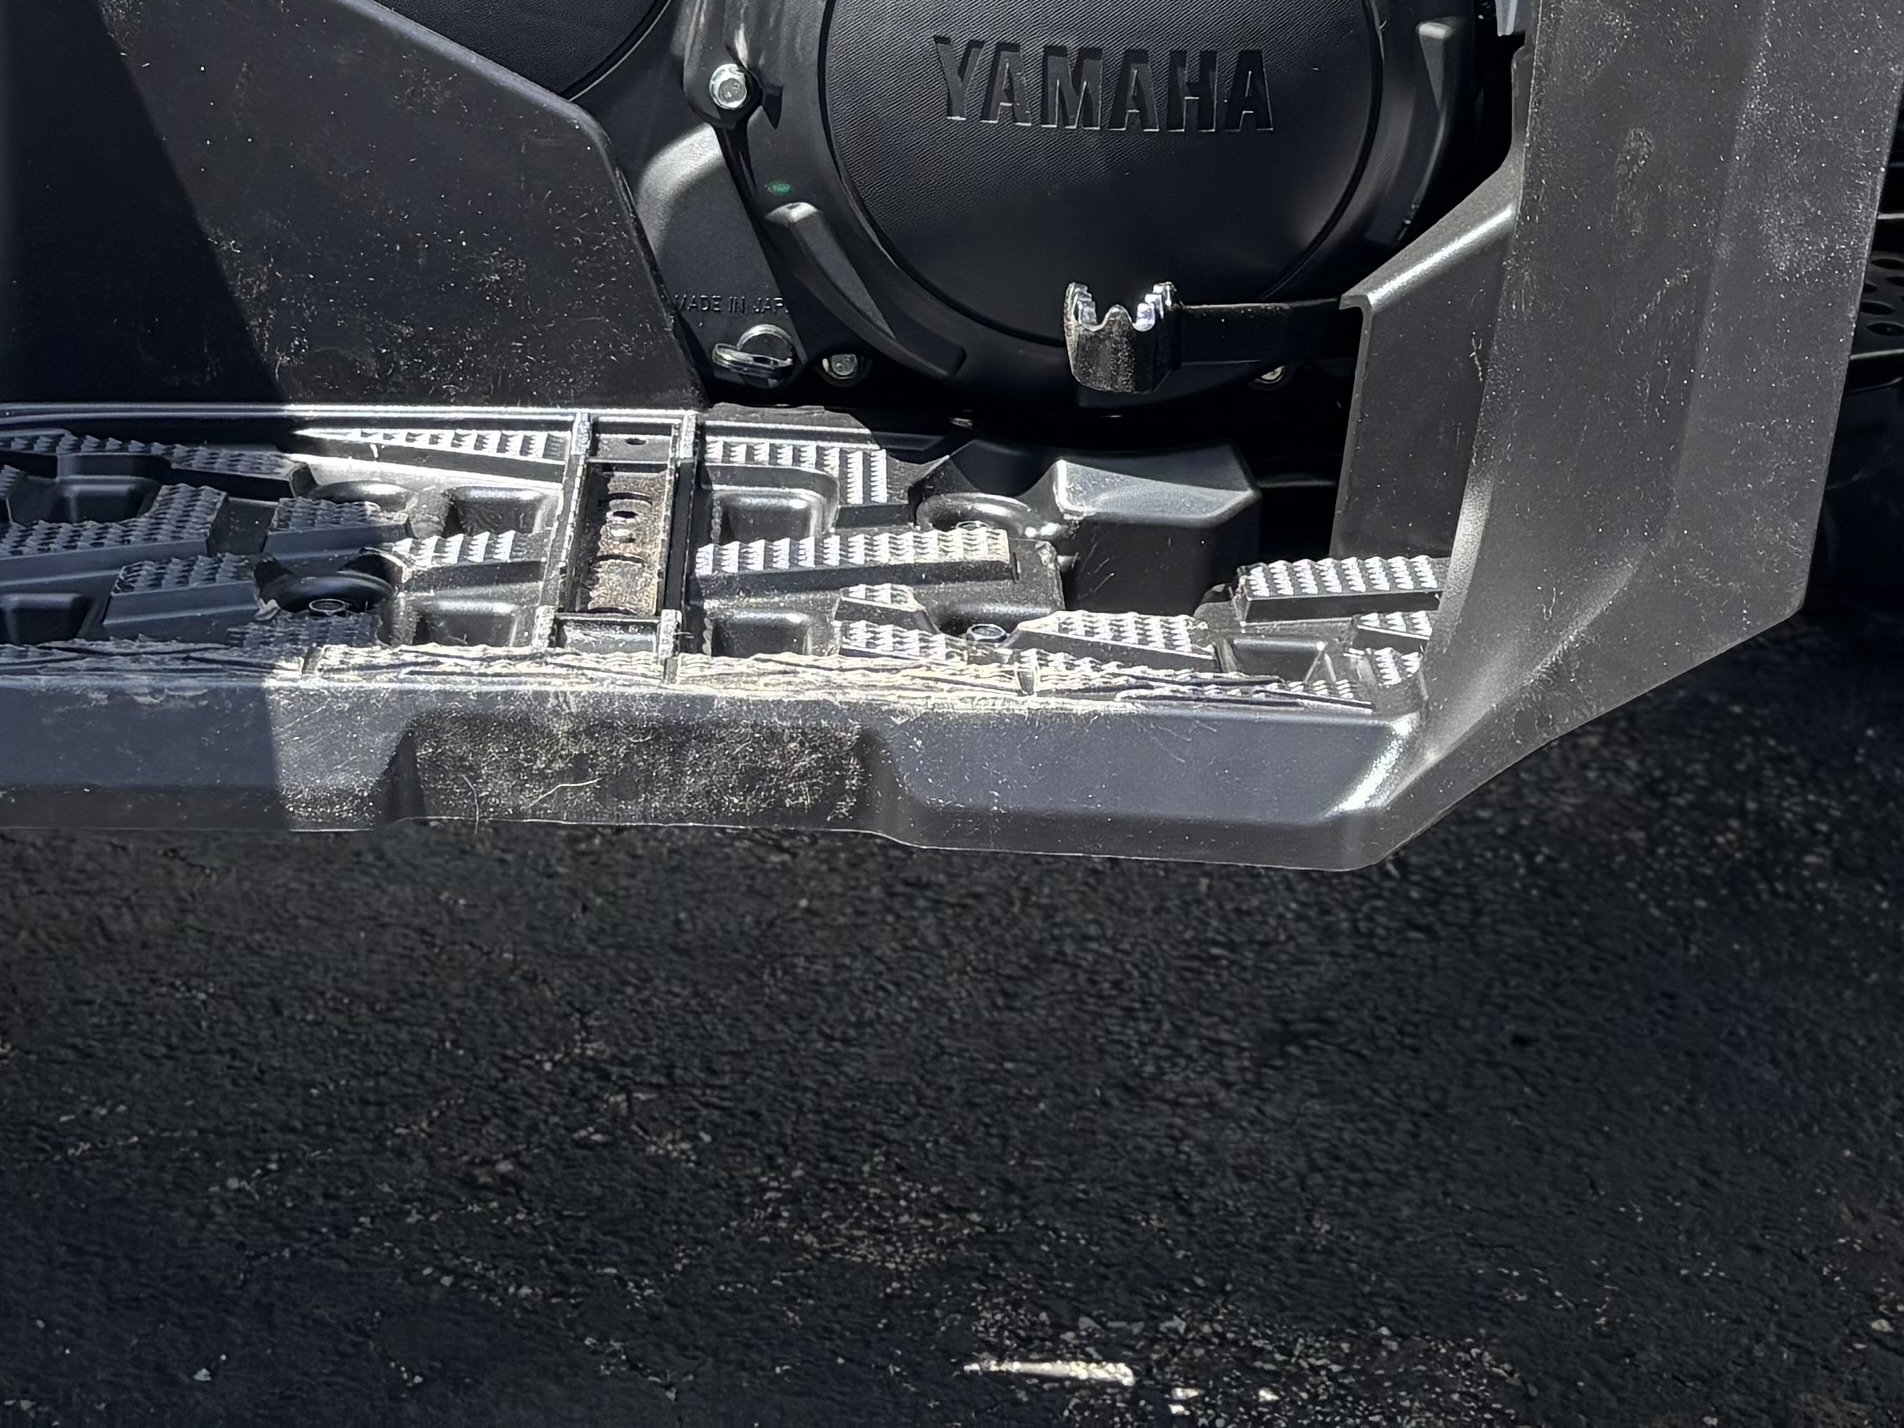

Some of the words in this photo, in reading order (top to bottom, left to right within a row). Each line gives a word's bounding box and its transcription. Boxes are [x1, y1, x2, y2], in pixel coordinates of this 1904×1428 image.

[932, 34, 1274, 133] YAMAHA
[727, 294, 747, 313] IN
[752, 295, 789, 314] JAP
